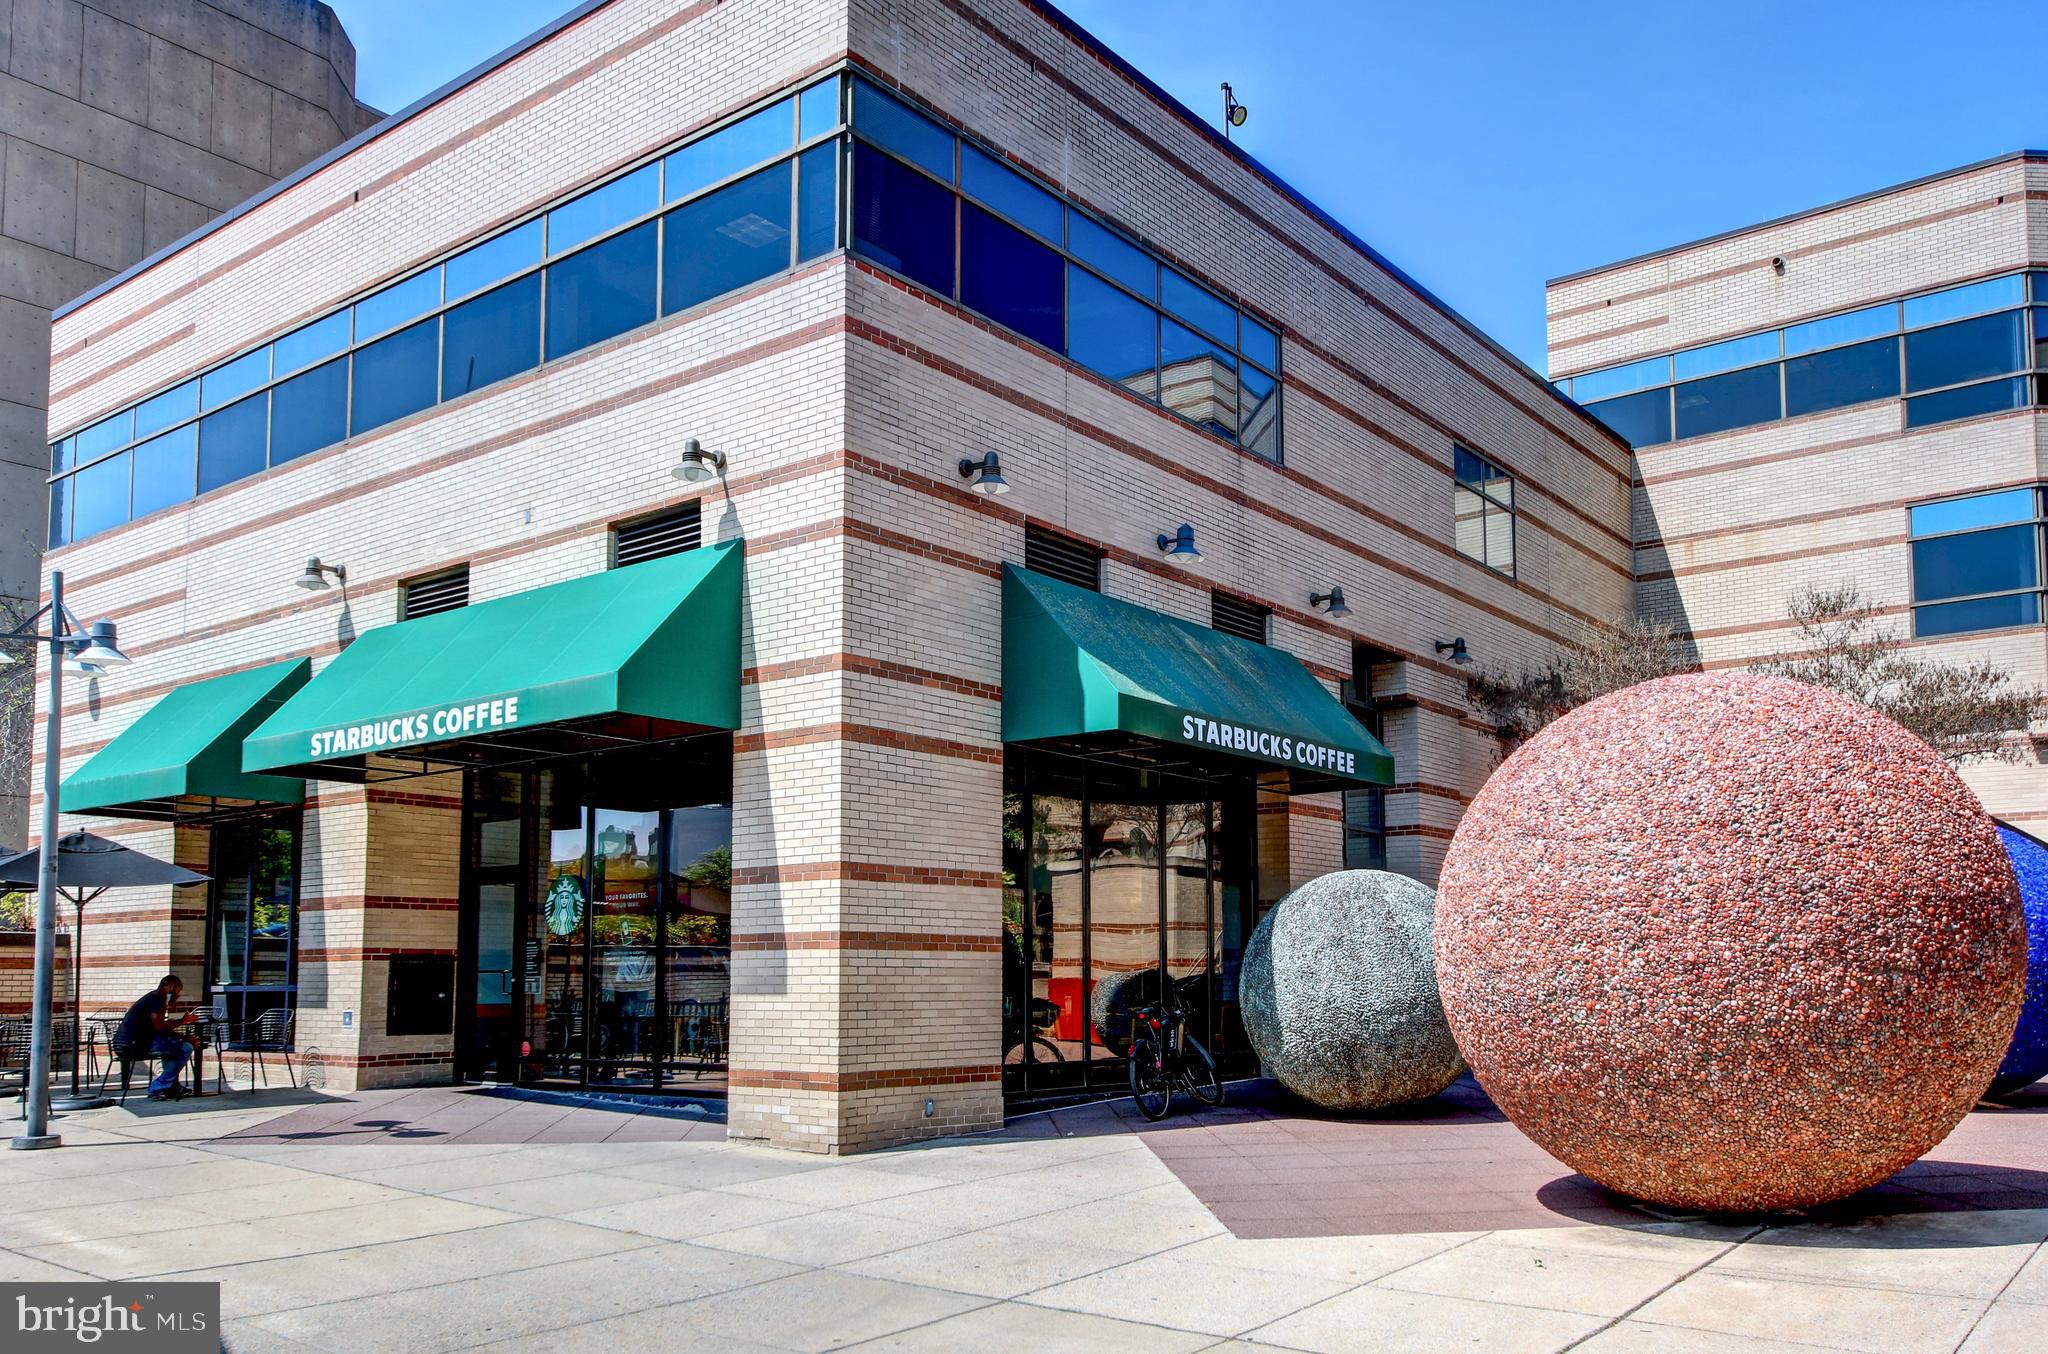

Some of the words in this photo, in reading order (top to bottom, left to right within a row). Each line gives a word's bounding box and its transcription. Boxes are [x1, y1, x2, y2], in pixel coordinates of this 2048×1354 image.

[310, 714, 429, 757] STARBUCKS
[432, 696, 519, 736] COFFEE
[1182, 715, 1292, 760] STARBUCKS
[1295, 741, 1355, 774] COFFEE
